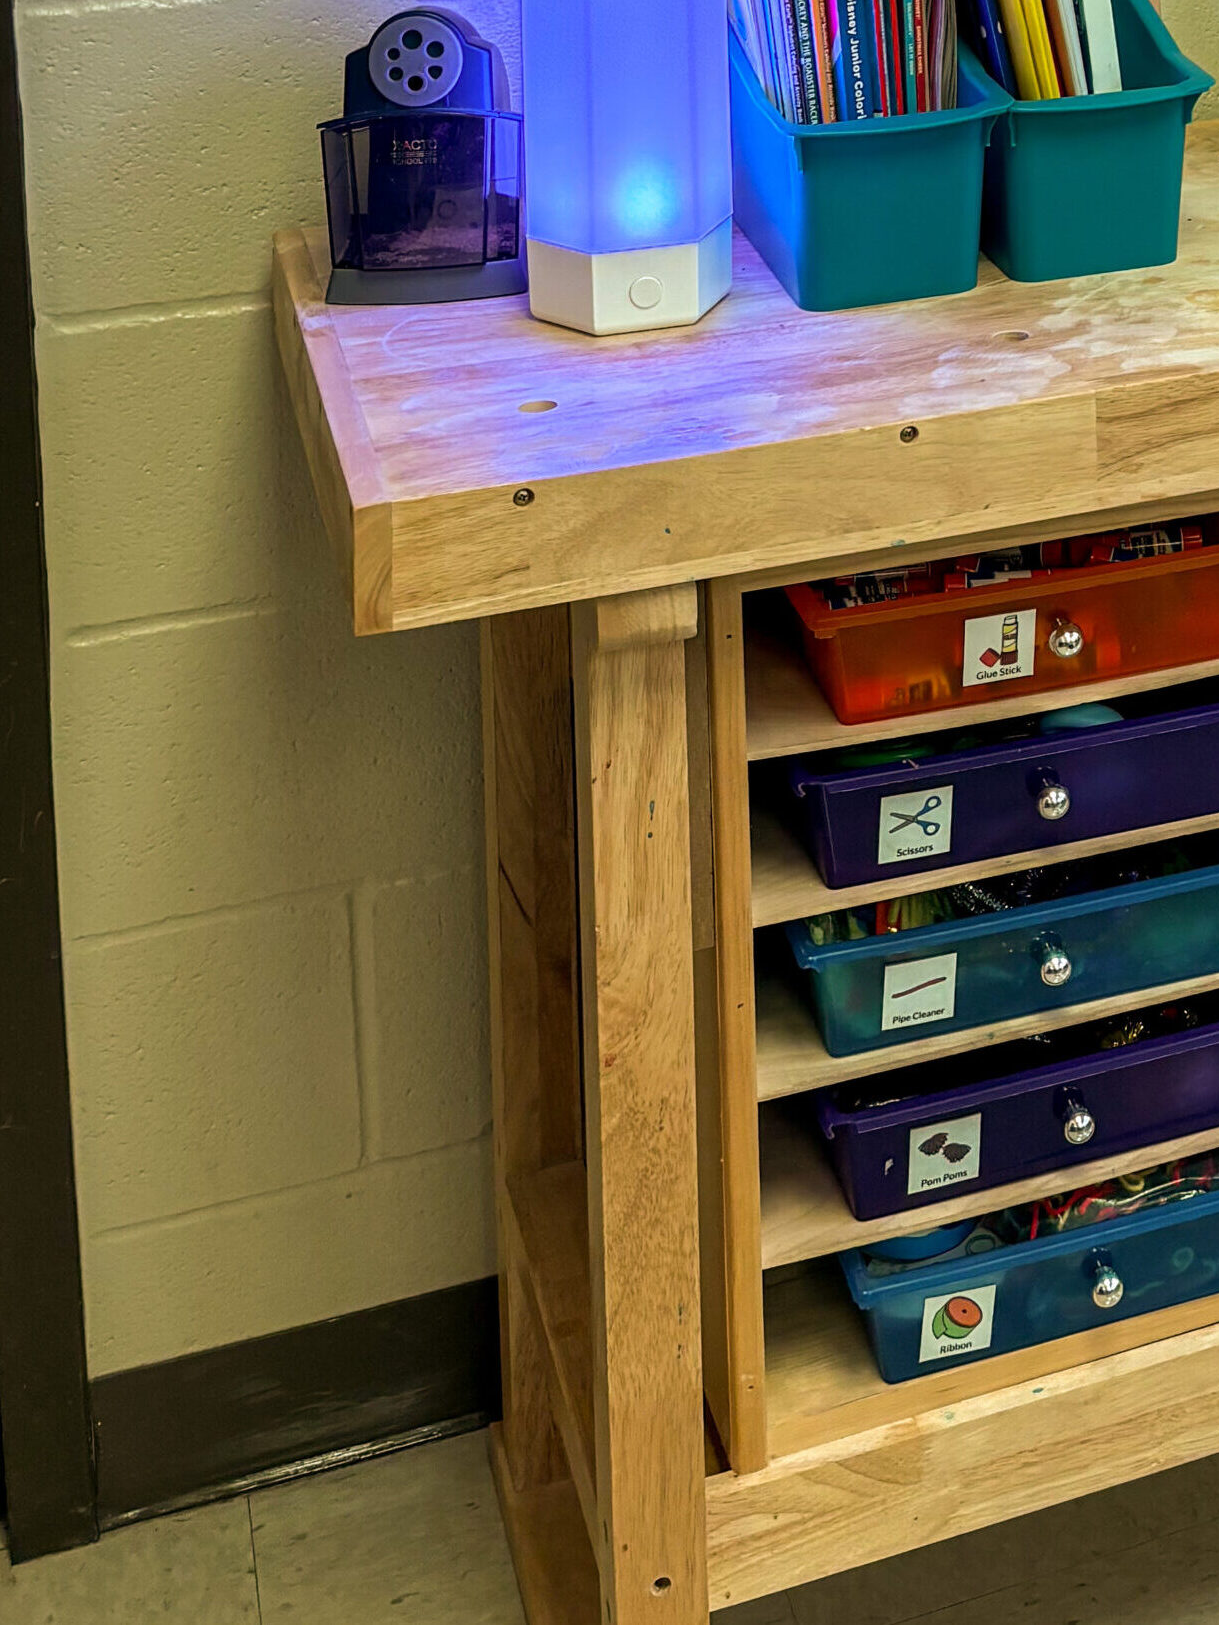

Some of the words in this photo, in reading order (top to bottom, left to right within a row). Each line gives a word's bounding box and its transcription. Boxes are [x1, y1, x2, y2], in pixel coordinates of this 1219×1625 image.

[800, 22, 809, 41] AND
[802, 41, 811, 56] THE
[850, 38, 861, 79] Junior
[804, 58, 815, 103] ROADSTER
[977, 670, 997, 680] Glue
[999, 665, 1021, 677] Stick
[896, 843, 933, 858] Scissors
[892, 1012, 910, 1025] Pipe
[911, 1006, 945, 1021] Cleaner
[920, 1174, 940, 1188] Pom
[942, 1169, 967, 1182] Poms
[939, 1339, 972, 1354] Ribbon
